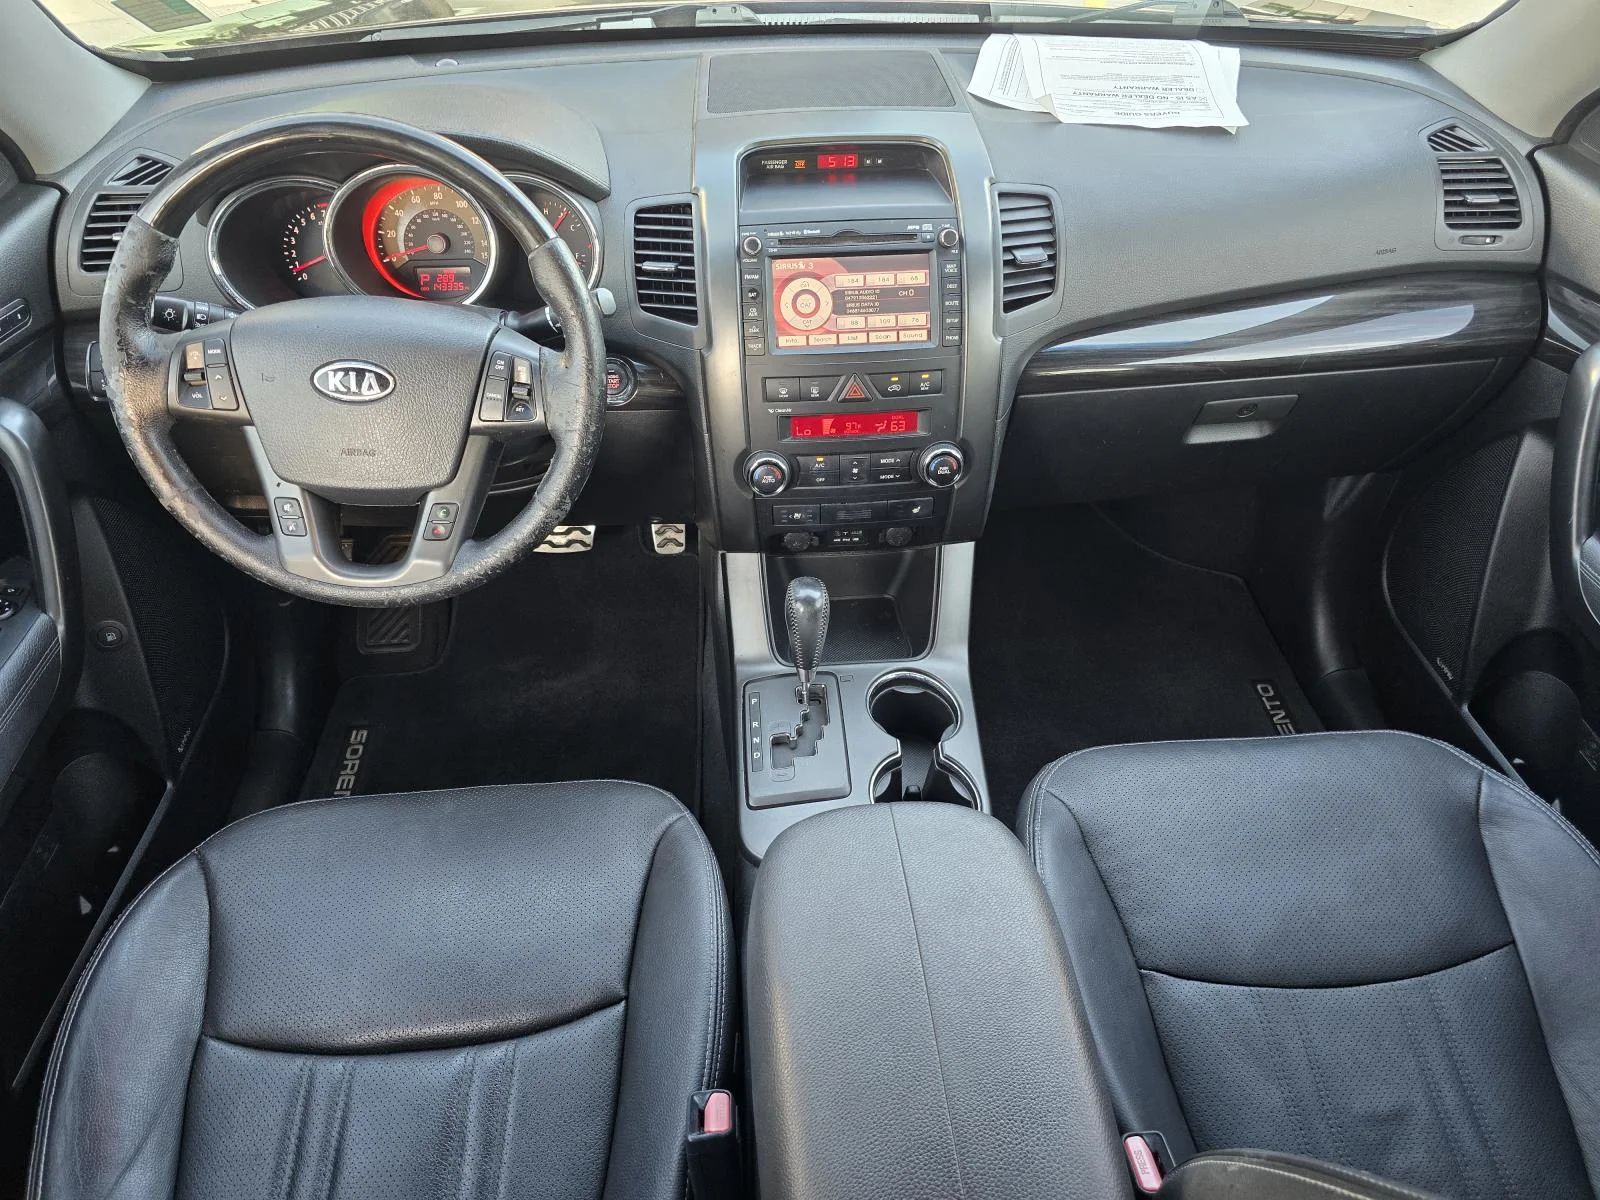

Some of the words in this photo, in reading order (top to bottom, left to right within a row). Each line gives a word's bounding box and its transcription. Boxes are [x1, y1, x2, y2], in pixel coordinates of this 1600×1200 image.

[455, 200, 468, 208] 100
[320, 209, 326, 218] 7
[543, 207, 549, 215] H
[310, 212, 316, 220] 6
[300, 218, 306, 226] 5
[293, 226, 299, 234] 4
[290, 236, 296, 244] 3
[290, 250, 296, 258] 2
[808, 262, 814, 270] 3
[302, 272, 308, 280] 0
[420, 274, 430, 285] P
[436, 273, 455, 282] 289
[433, 282, 464, 290] 143335
[327, 370, 381, 395] KIA
[890, 420, 906, 431] 63
[796, 426, 811, 436] Lo
[340, 447, 376, 457] AIRBAG
